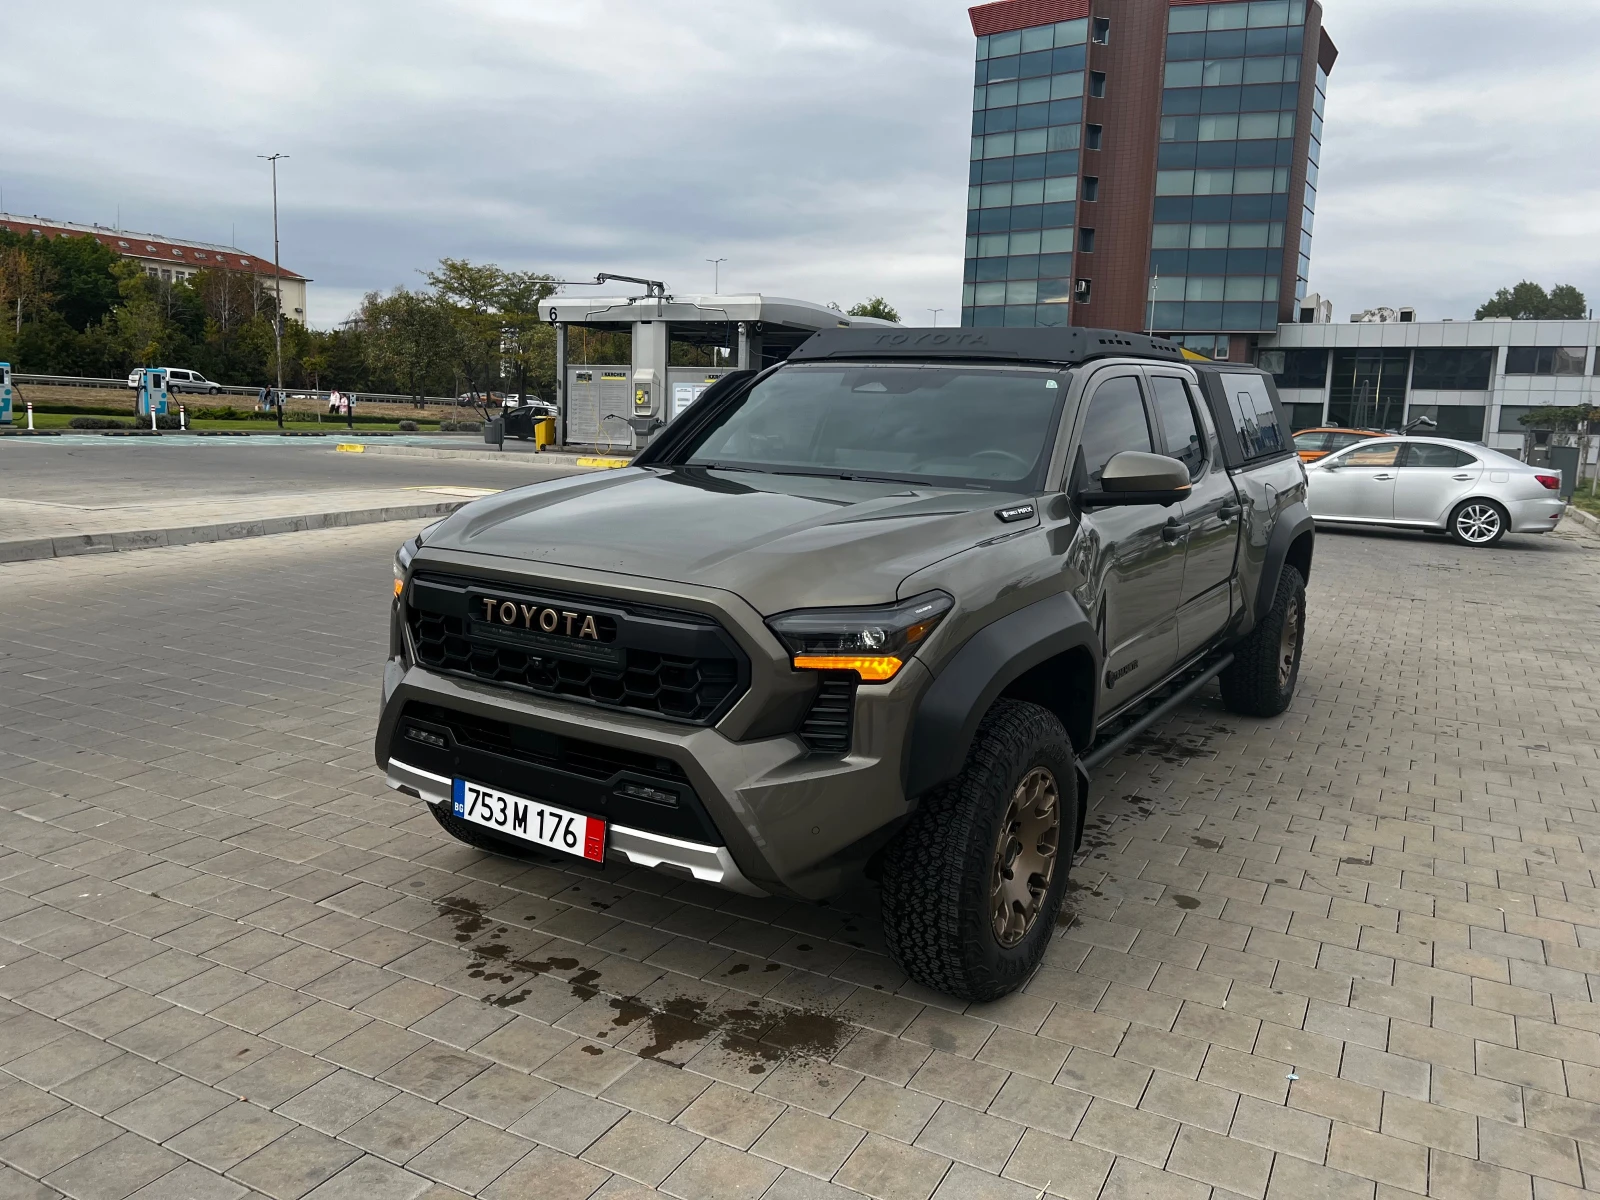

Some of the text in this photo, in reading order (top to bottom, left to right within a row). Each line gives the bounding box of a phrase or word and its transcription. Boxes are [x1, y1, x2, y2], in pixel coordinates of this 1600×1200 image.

[549, 306, 558, 321] 6
[875, 333, 988, 346] TOYOTA
[483, 598, 598, 640] TOYOTA
[454, 801, 464, 813] BG
[467, 786, 577, 848] 753 M 176
